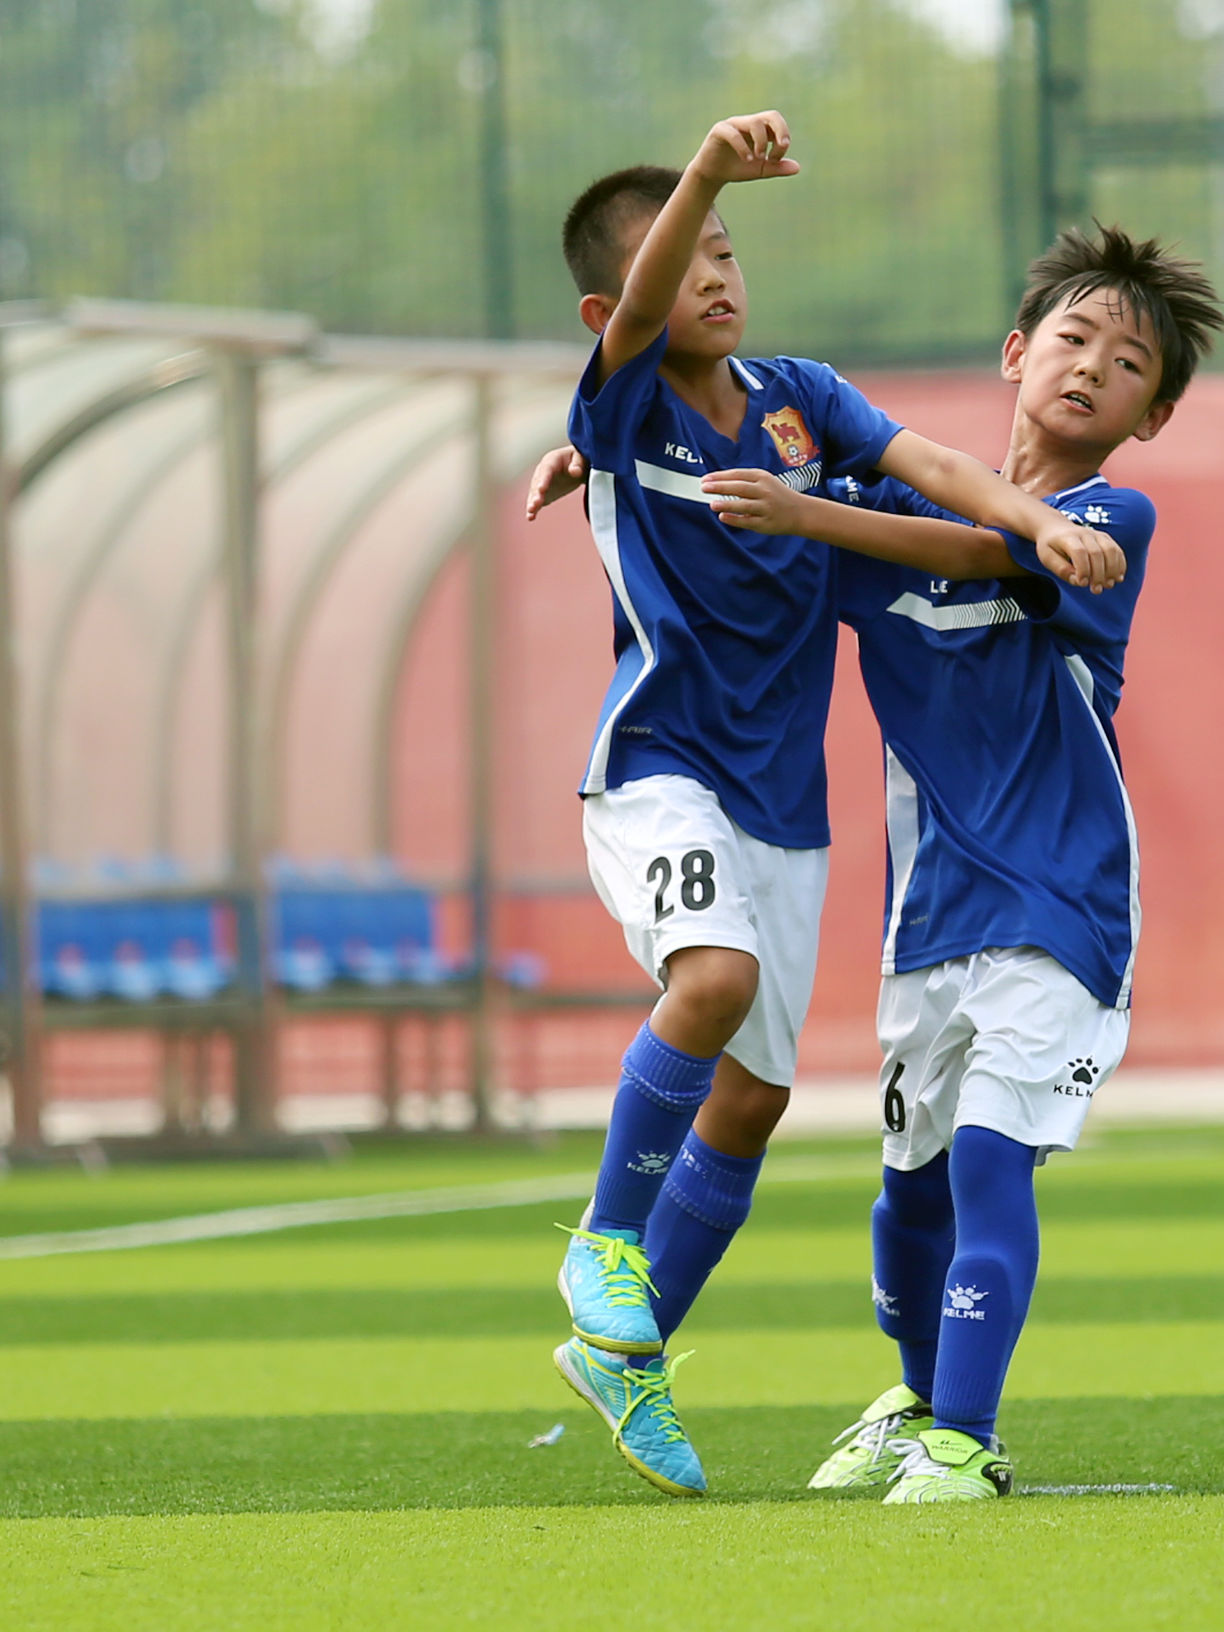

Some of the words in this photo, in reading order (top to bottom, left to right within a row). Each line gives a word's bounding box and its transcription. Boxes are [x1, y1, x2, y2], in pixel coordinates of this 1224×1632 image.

[664, 442, 704, 464] KEL
[646, 849, 716, 925] 28
[884, 1061, 906, 1133] 6
[943, 1307, 985, 1320] KELME
